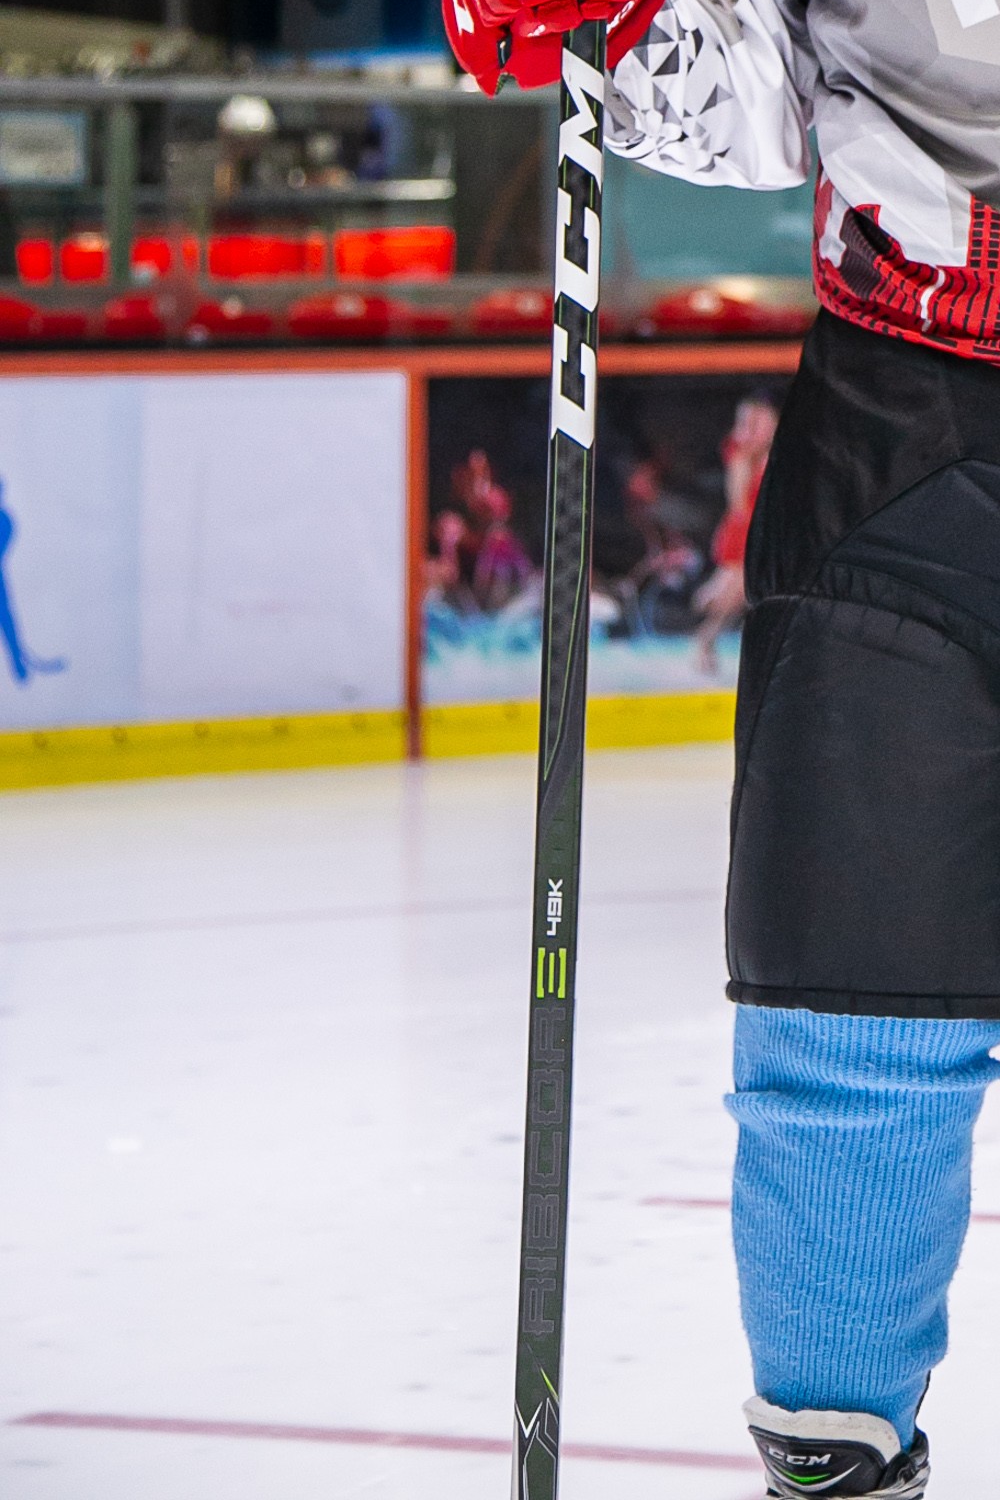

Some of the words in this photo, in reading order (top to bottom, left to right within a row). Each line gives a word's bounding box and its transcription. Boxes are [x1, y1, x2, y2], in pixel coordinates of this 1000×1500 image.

[550, 47, 605, 450] CCM
[546, 878, 564, 936] 49K
[766, 1445, 832, 1466] CCM
